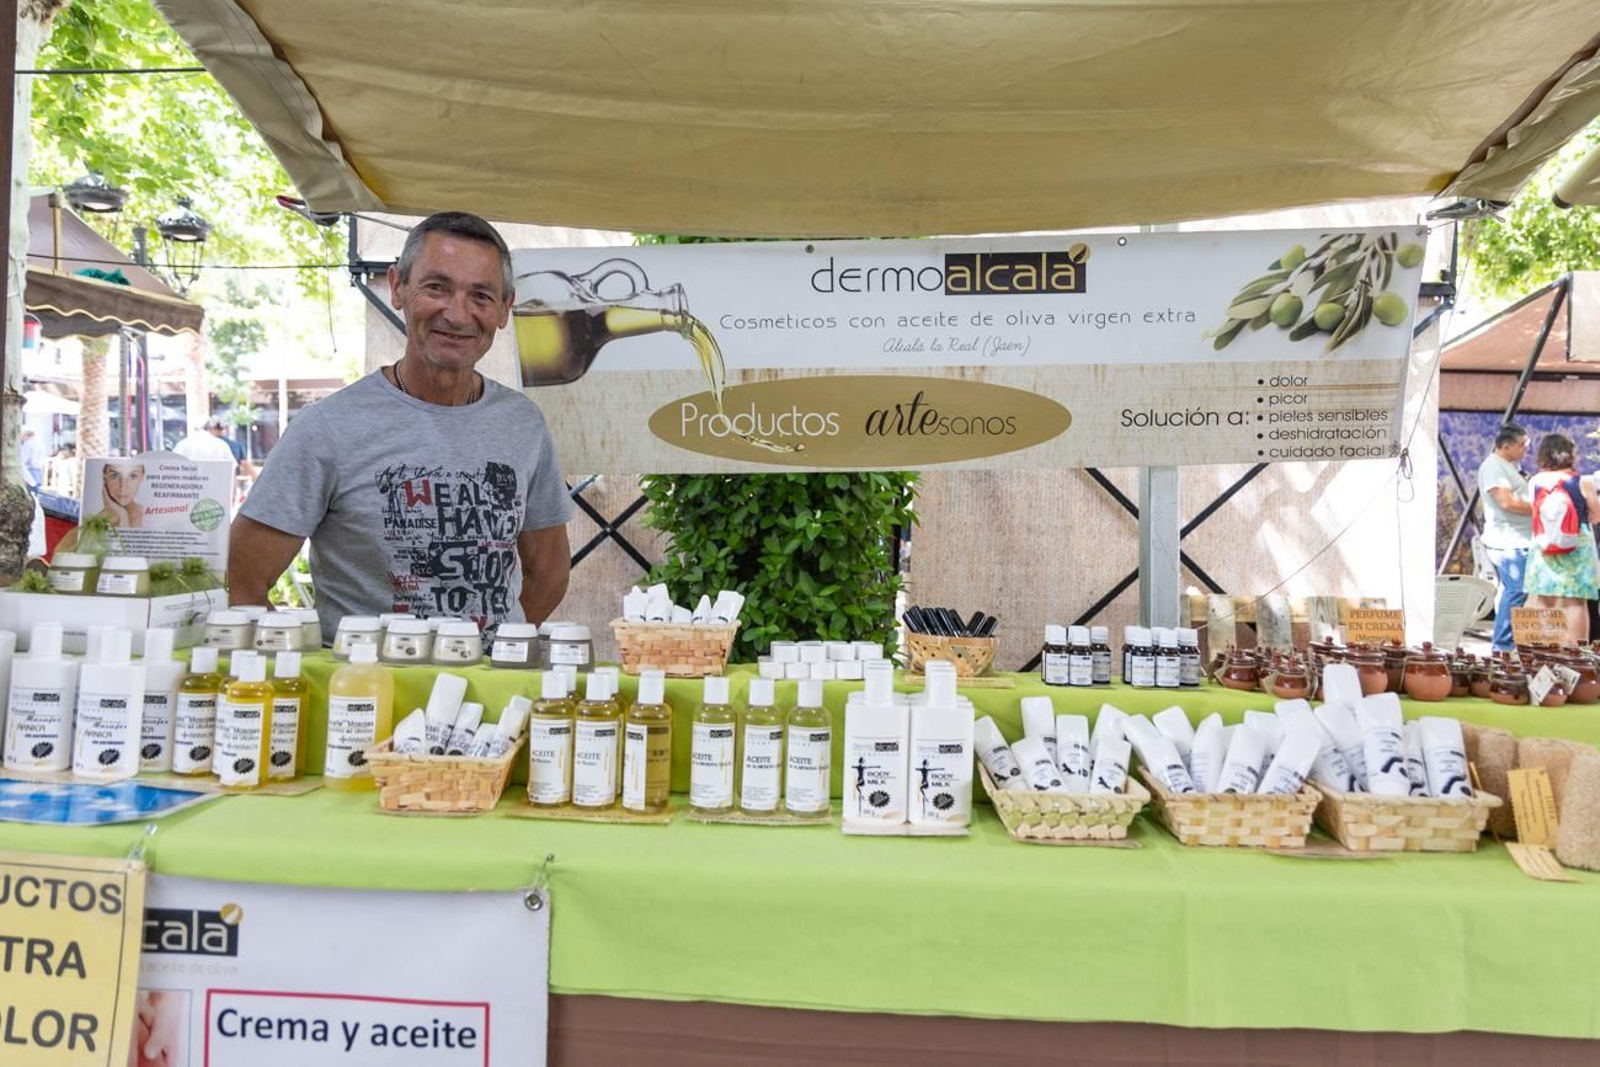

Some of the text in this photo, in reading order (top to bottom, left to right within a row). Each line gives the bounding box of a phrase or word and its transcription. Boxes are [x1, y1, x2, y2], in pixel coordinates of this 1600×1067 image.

[719, 307, 1196, 330] Cosméticos con aceite de oliva virgen extra
[882, 337, 925, 353] Alcalá
[929, 338, 943, 352] la
[949, 336, 979, 352] Real
[1268, 374, 1309, 388] dolor
[1268, 392, 1309, 406] picor
[680, 390, 1017, 438] Productos artesanos
[1120, 406, 1250, 428] Solución a:
[1268, 408, 1388, 424] pieles sensibles
[1268, 426, 1387, 441] deshidratación
[1268, 444, 1385, 459] cuidado facial
[144, 503, 189, 516] Artesanal
[383, 516, 438, 530] PARADISE
[1349, 609, 1402, 619] PERFUME
[1515, 609, 1567, 619] PERFUME
[1349, 622, 1404, 631] EN CREMA
[1515, 621, 1529, 630] EN
[746, 755, 773, 764] ACEITE
[789, 755, 813, 765] ACEITE
[0, 1005, 99, 1053] LOR
[216, 1007, 477, 1052] Crema y aceite
